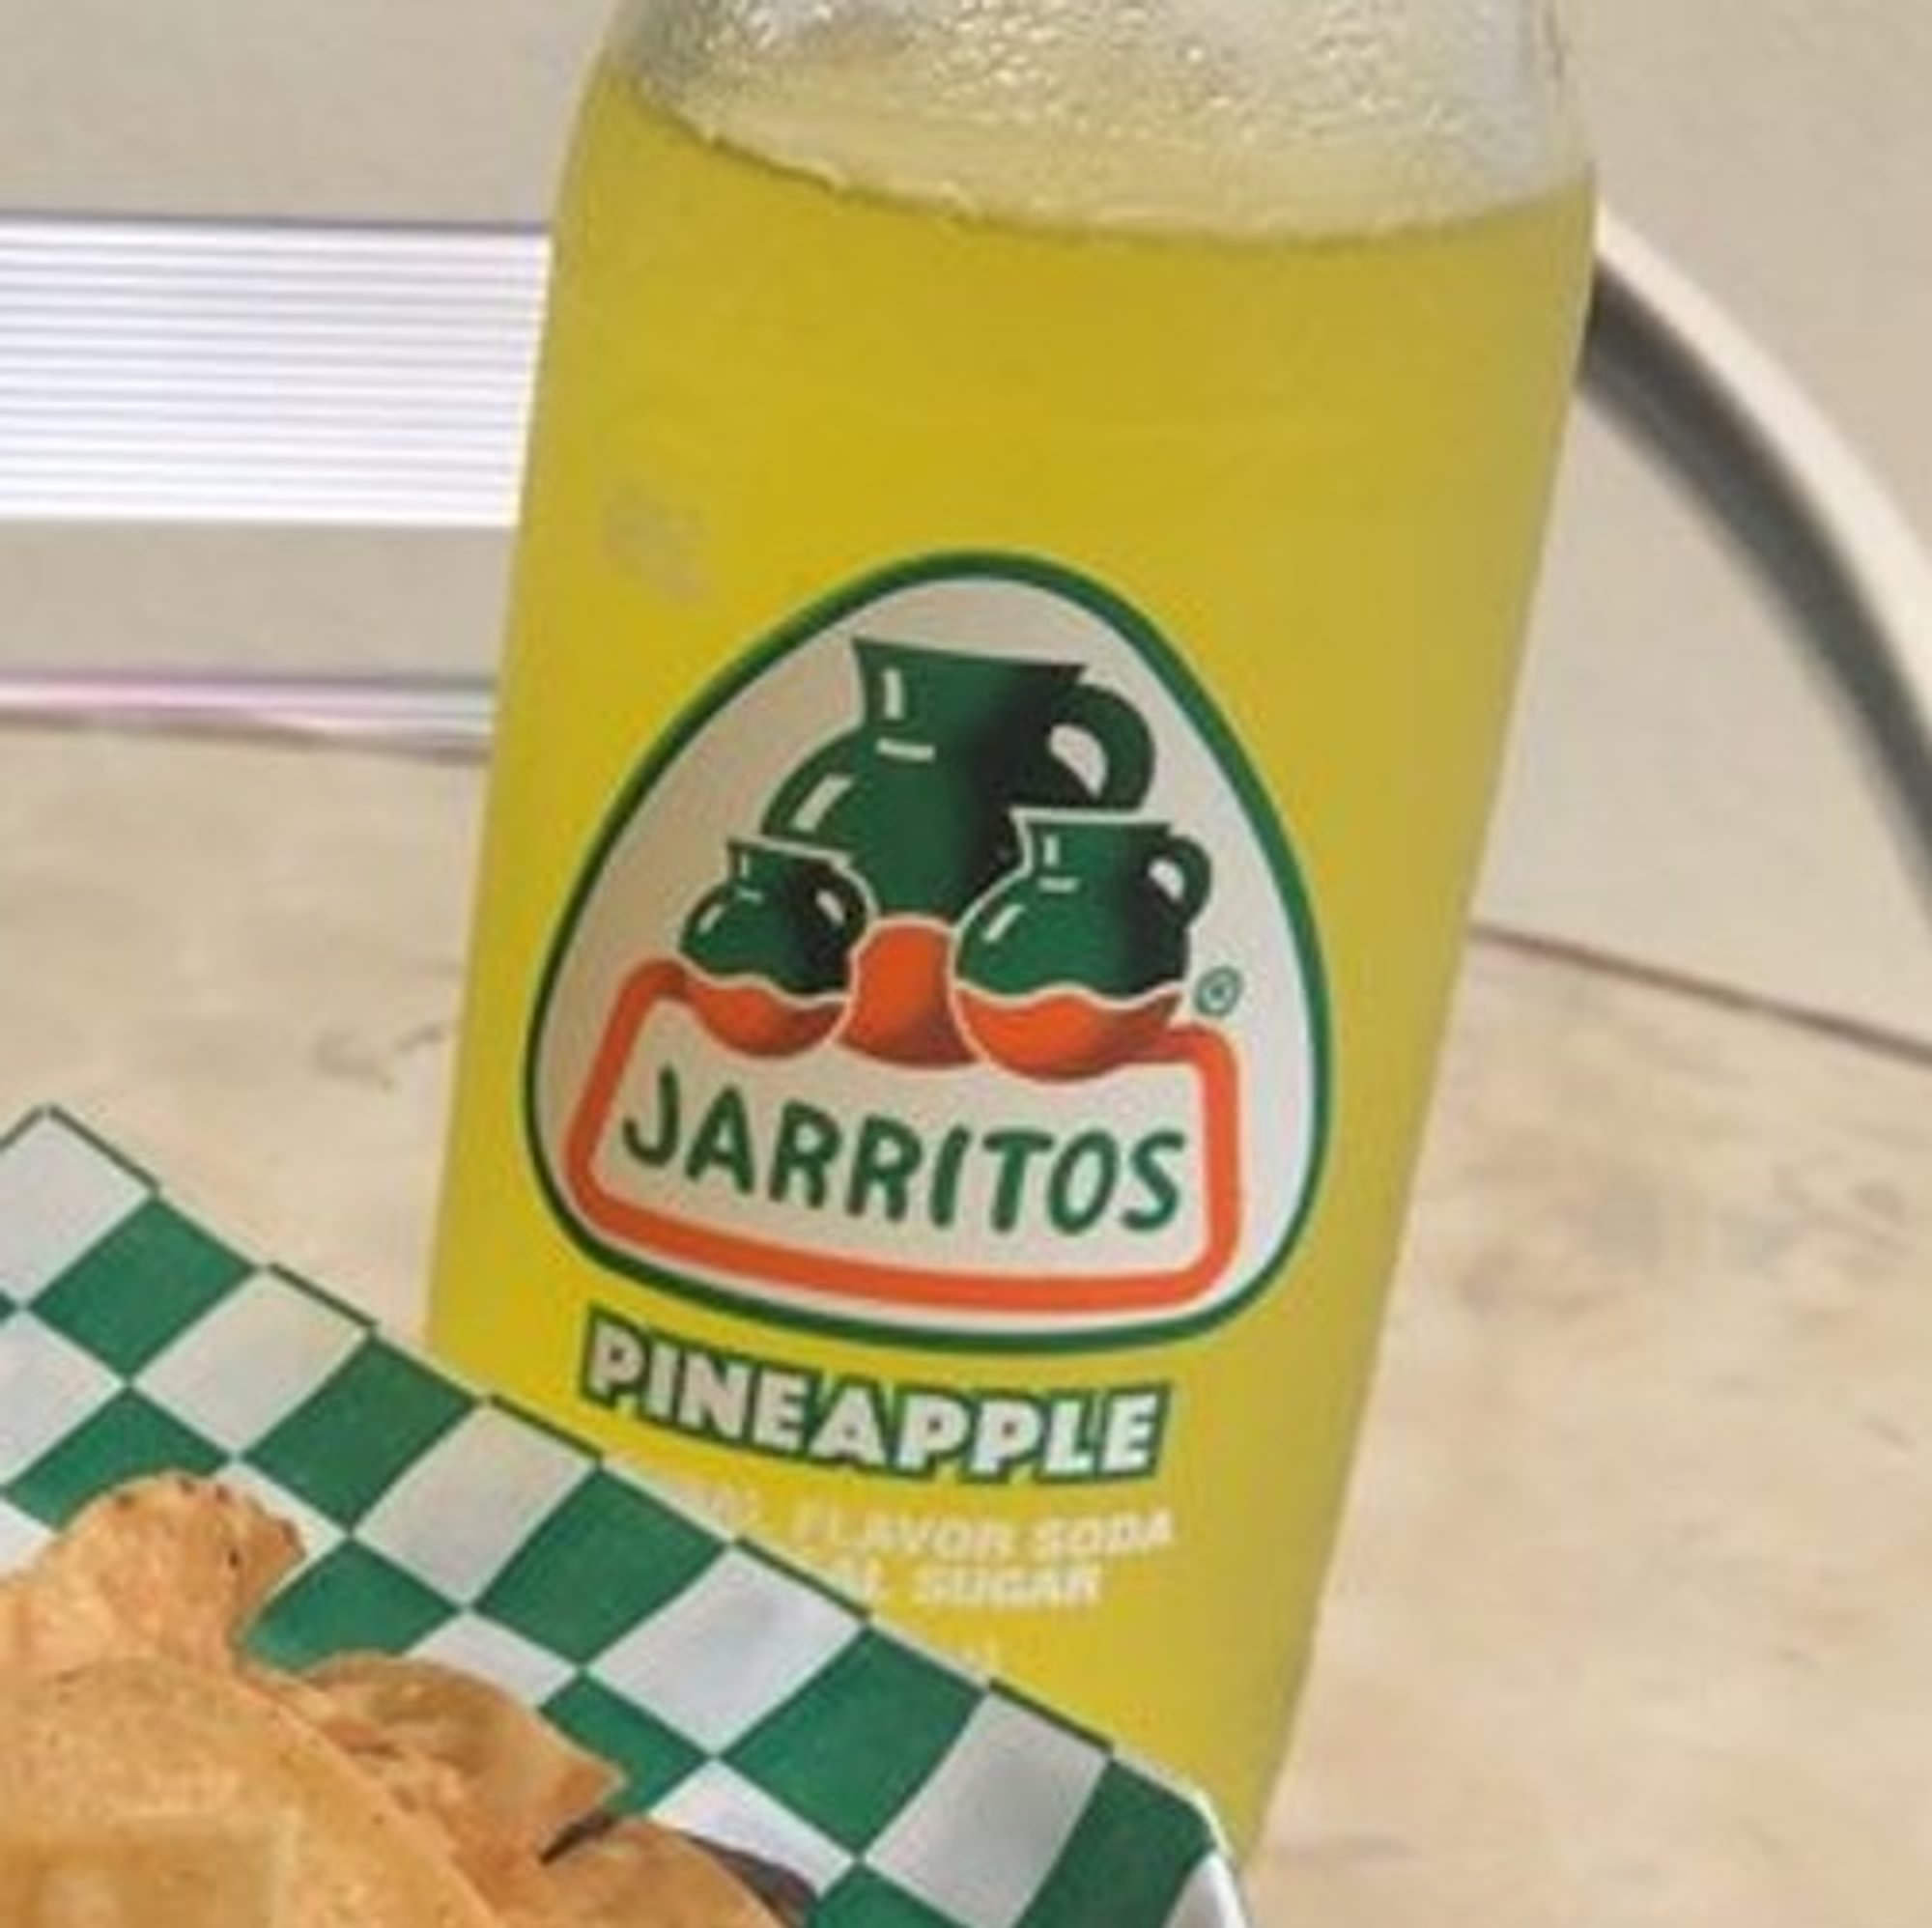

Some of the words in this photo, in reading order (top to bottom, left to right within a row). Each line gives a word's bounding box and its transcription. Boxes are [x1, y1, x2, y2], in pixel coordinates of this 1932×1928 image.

[622, 1066, 1184, 1236] JARRITOS
[582, 1308, 1172, 1482] PINEAPPLE
[793, 1502, 1014, 1557] FLAVOR
[1034, 1511, 1175, 1555] SODA
[912, 1561, 1103, 1610] SUGAR
